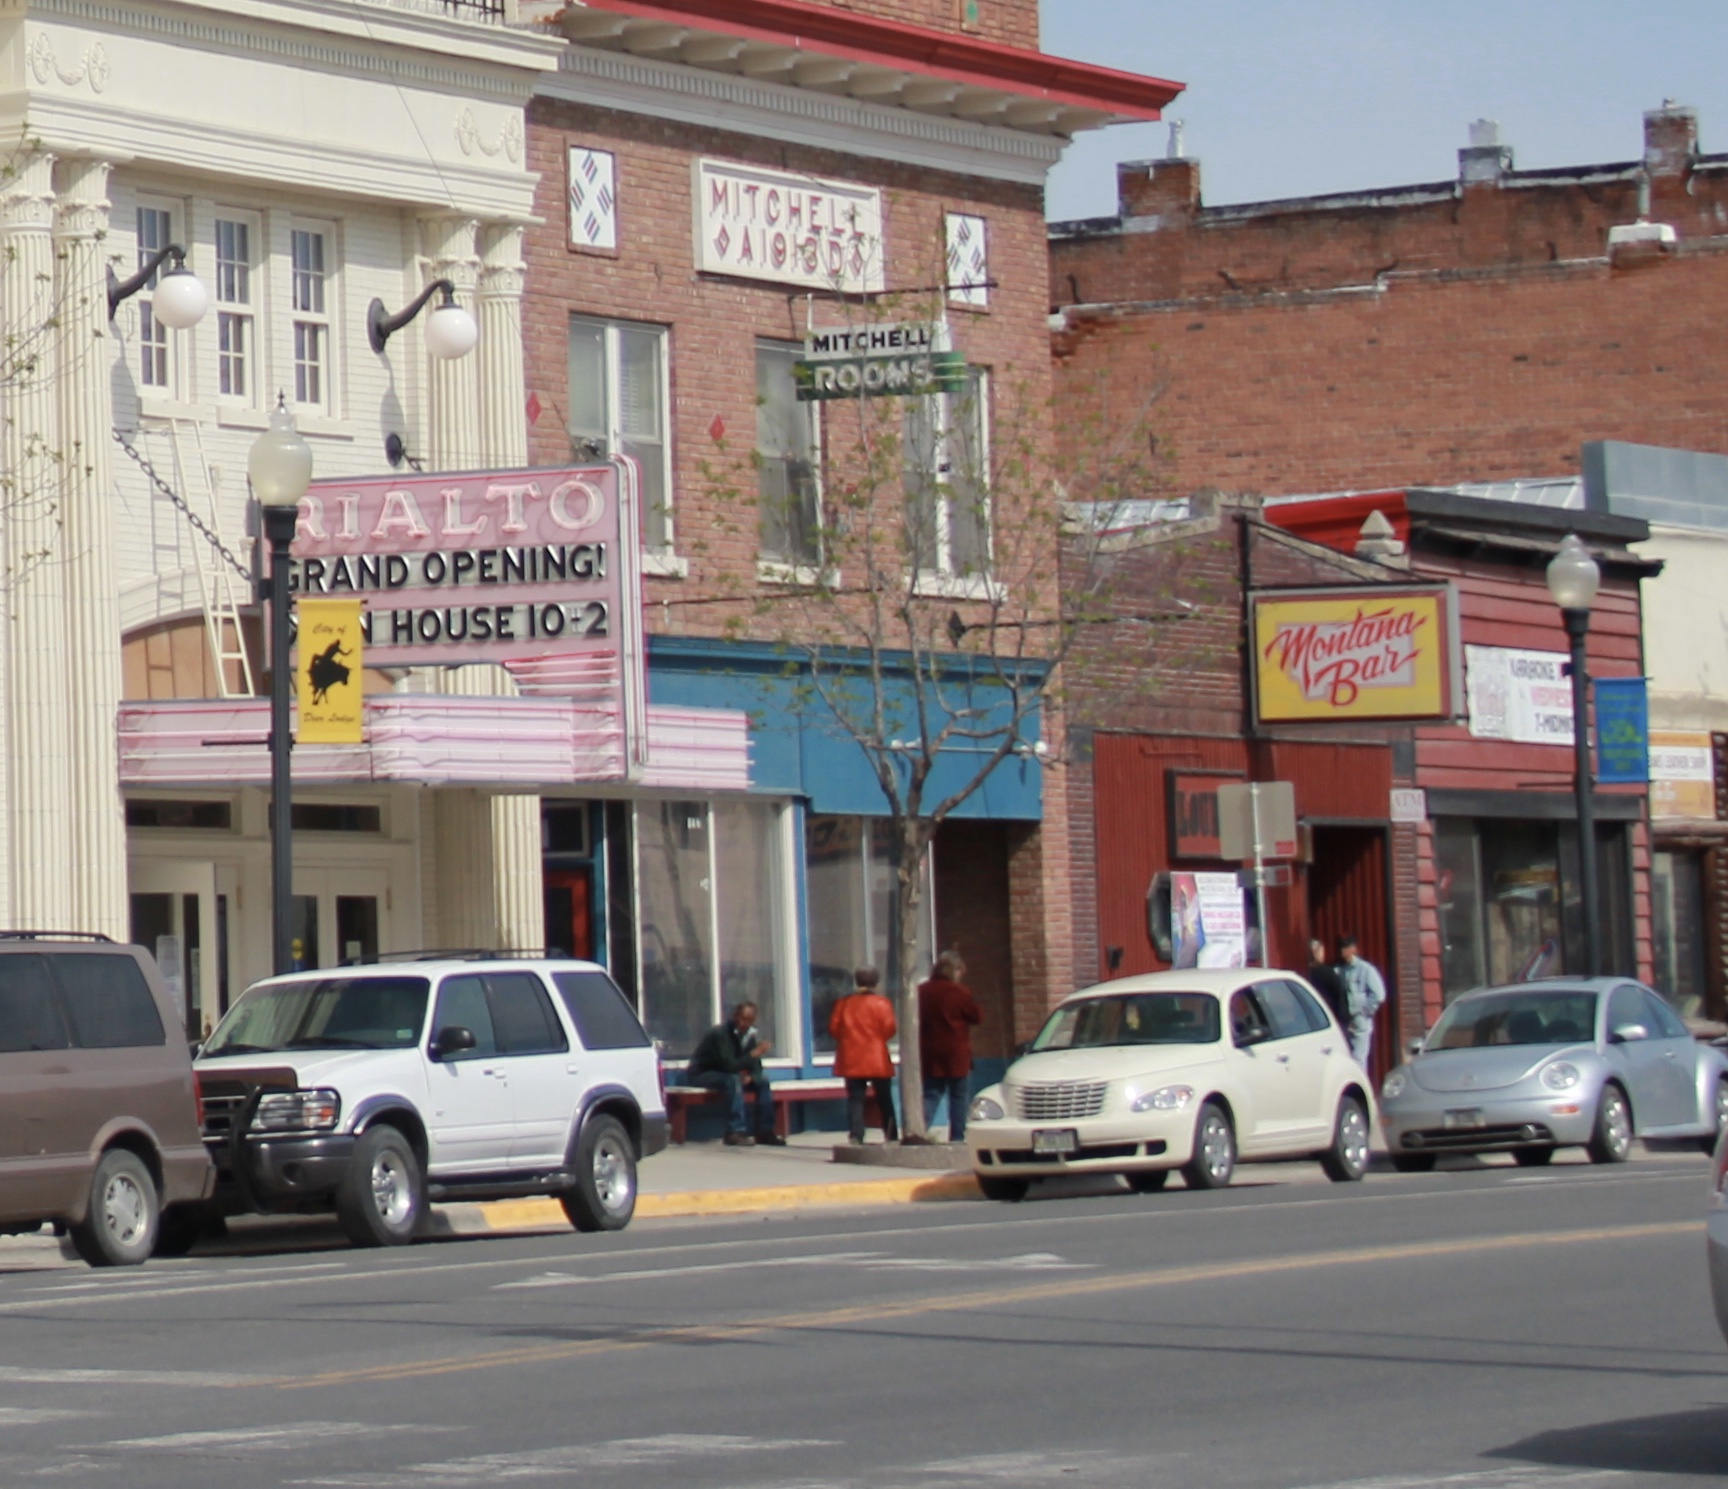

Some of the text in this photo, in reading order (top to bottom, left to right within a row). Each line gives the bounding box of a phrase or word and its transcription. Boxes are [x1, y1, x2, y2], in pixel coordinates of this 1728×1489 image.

[710, 177, 865, 243] MITCHELL
[812, 327, 931, 354] MITCHELL
[814, 358, 935, 394] ROOMS
[292, 479, 605, 542] RIALTO
[422, 542, 607, 589] OPENING!
[392, 606, 515, 644] HOUSE
[1263, 606, 1428, 696] Montana
[1312, 644, 1422, 708] Bar
